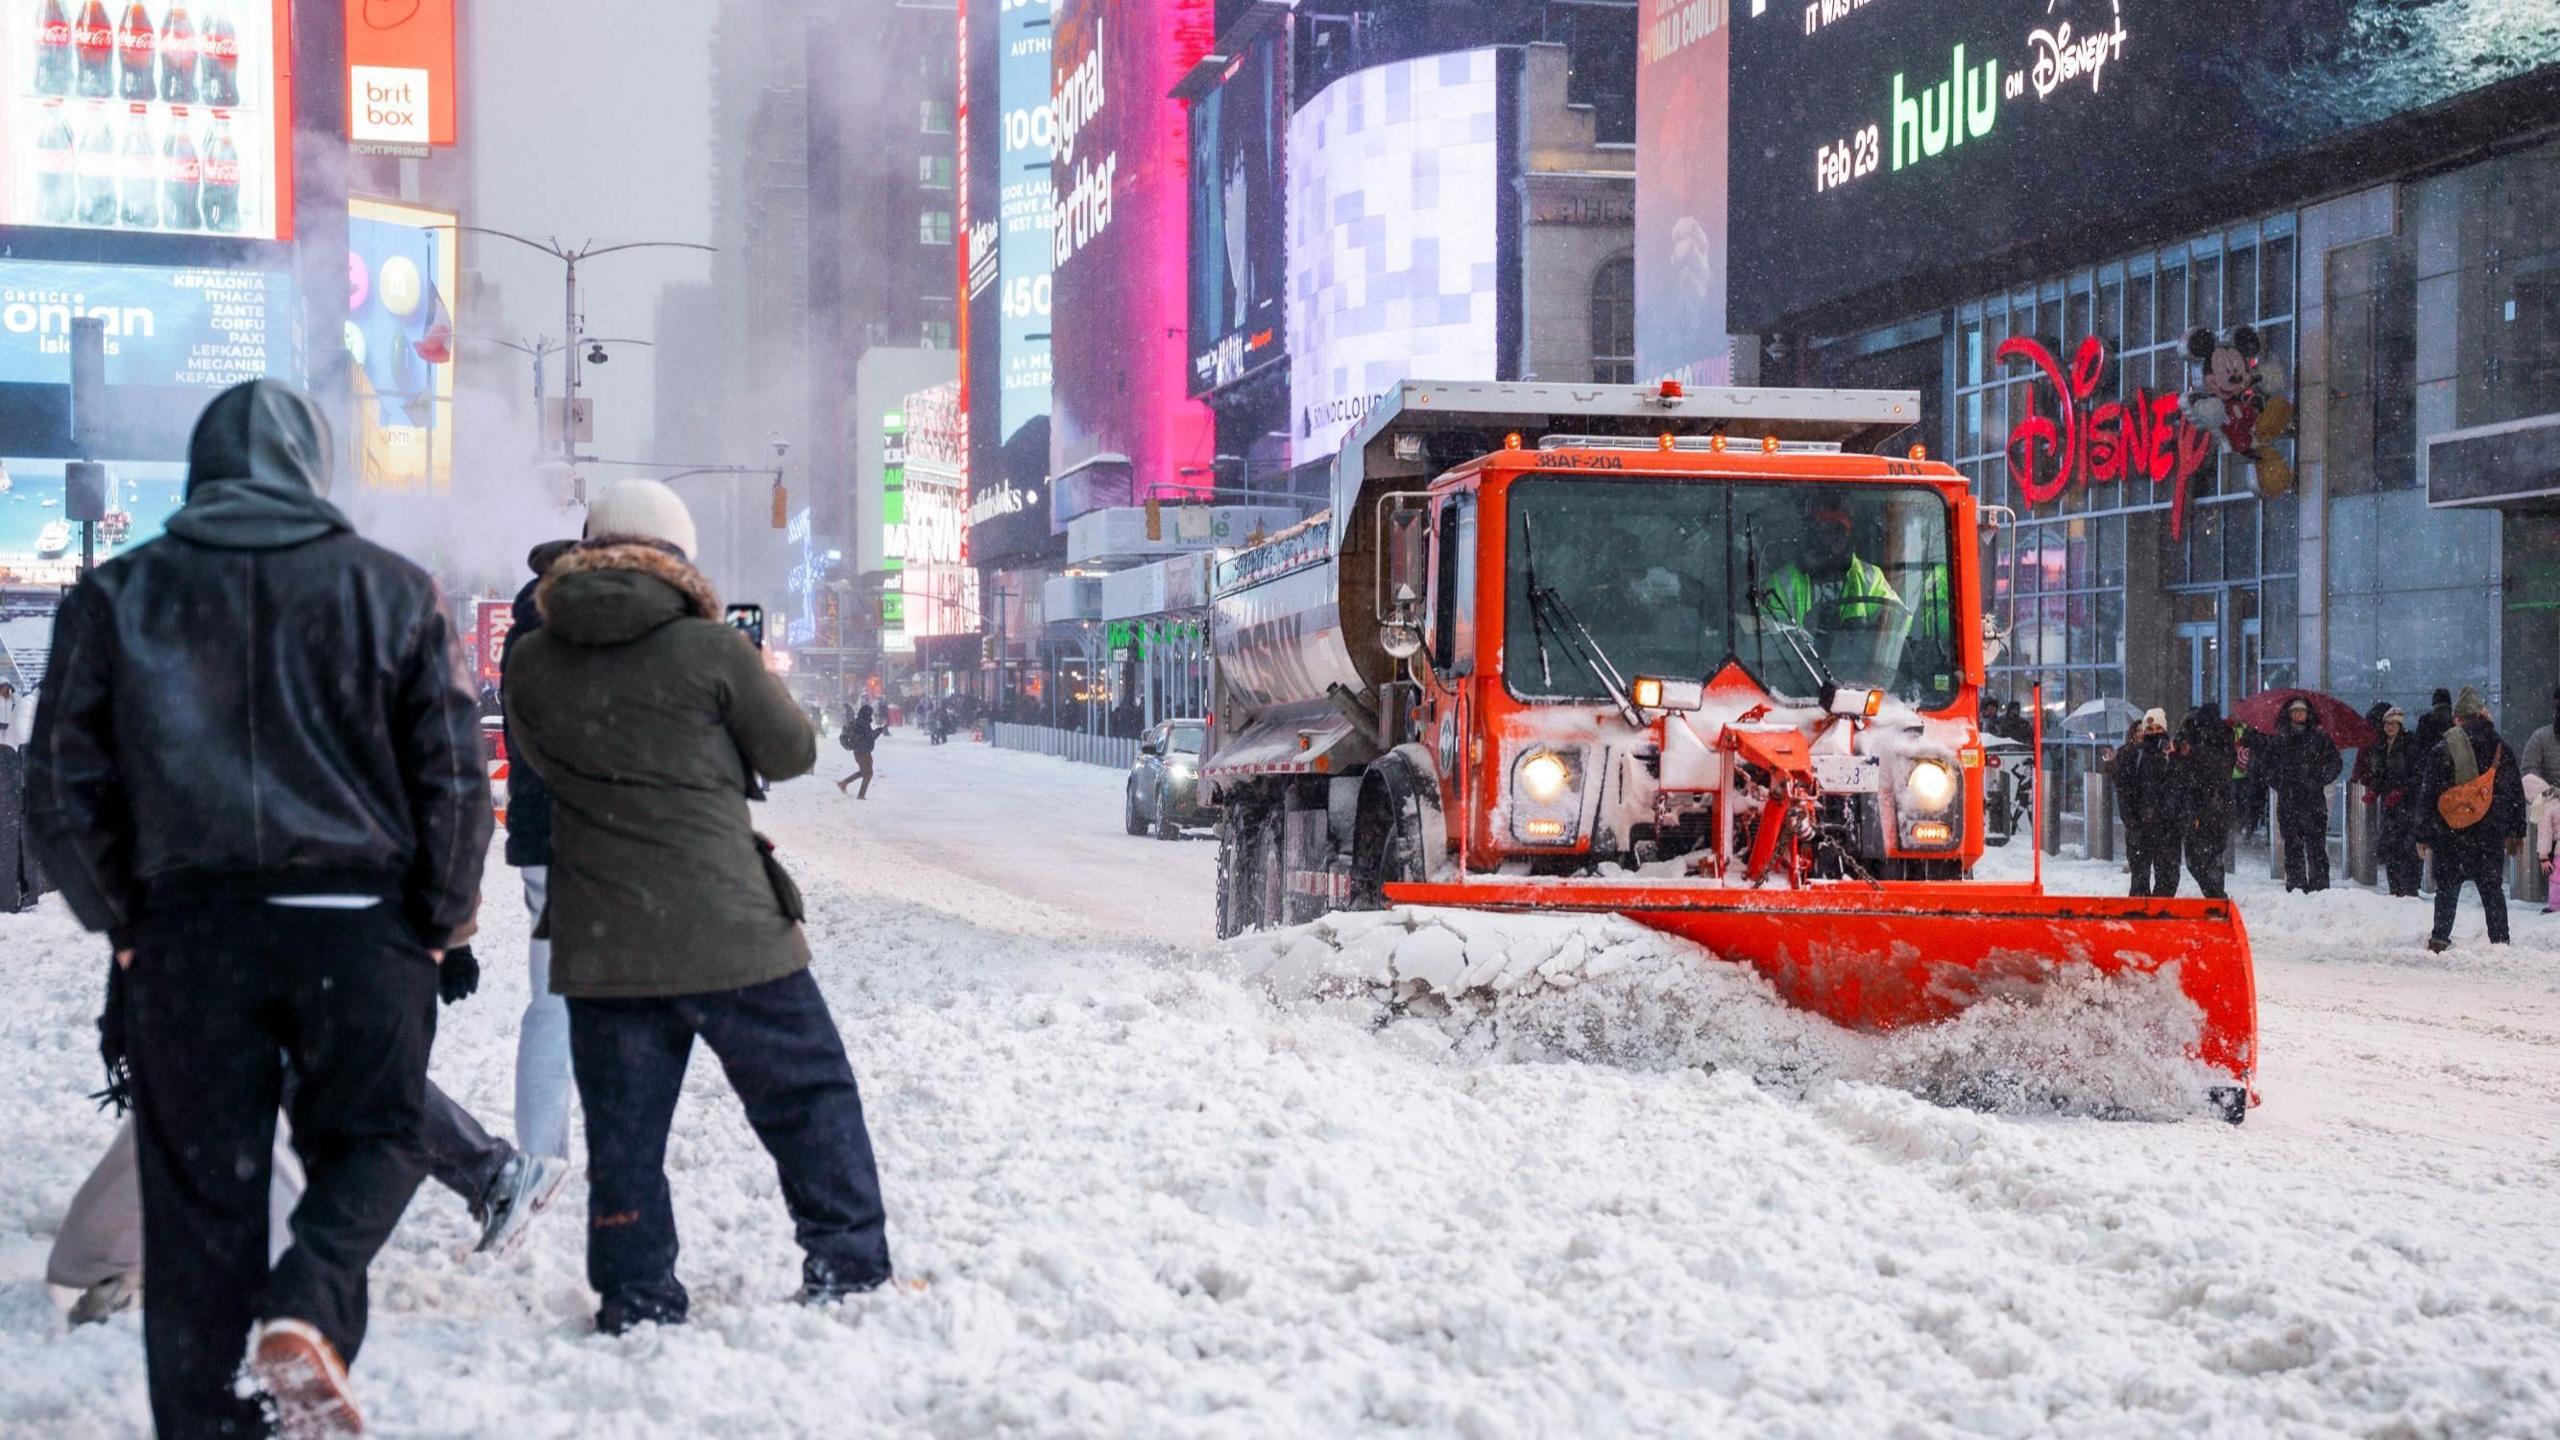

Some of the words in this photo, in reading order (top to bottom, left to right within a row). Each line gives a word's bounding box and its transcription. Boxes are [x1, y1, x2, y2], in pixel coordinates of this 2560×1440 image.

[367, 81, 411, 104] brit
[1050, 17, 1105, 166] signal
[367, 104, 414, 126] box
[1818, 140, 1851, 193] Feb
[1854, 125, 1879, 177] 23
[1893, 43, 1997, 171] hulu
[1051, 151, 1116, 272] farther
[174, 273, 264, 289] KEFALONIA
[205, 290, 264, 303] ITHACA
[213, 304, 264, 317] ZANTE
[210, 318, 264, 331] CORFU
[229, 332, 264, 344] PAXI
[192, 344, 266, 358] LEFKADA
[188, 358, 266, 372] MEGANISI
